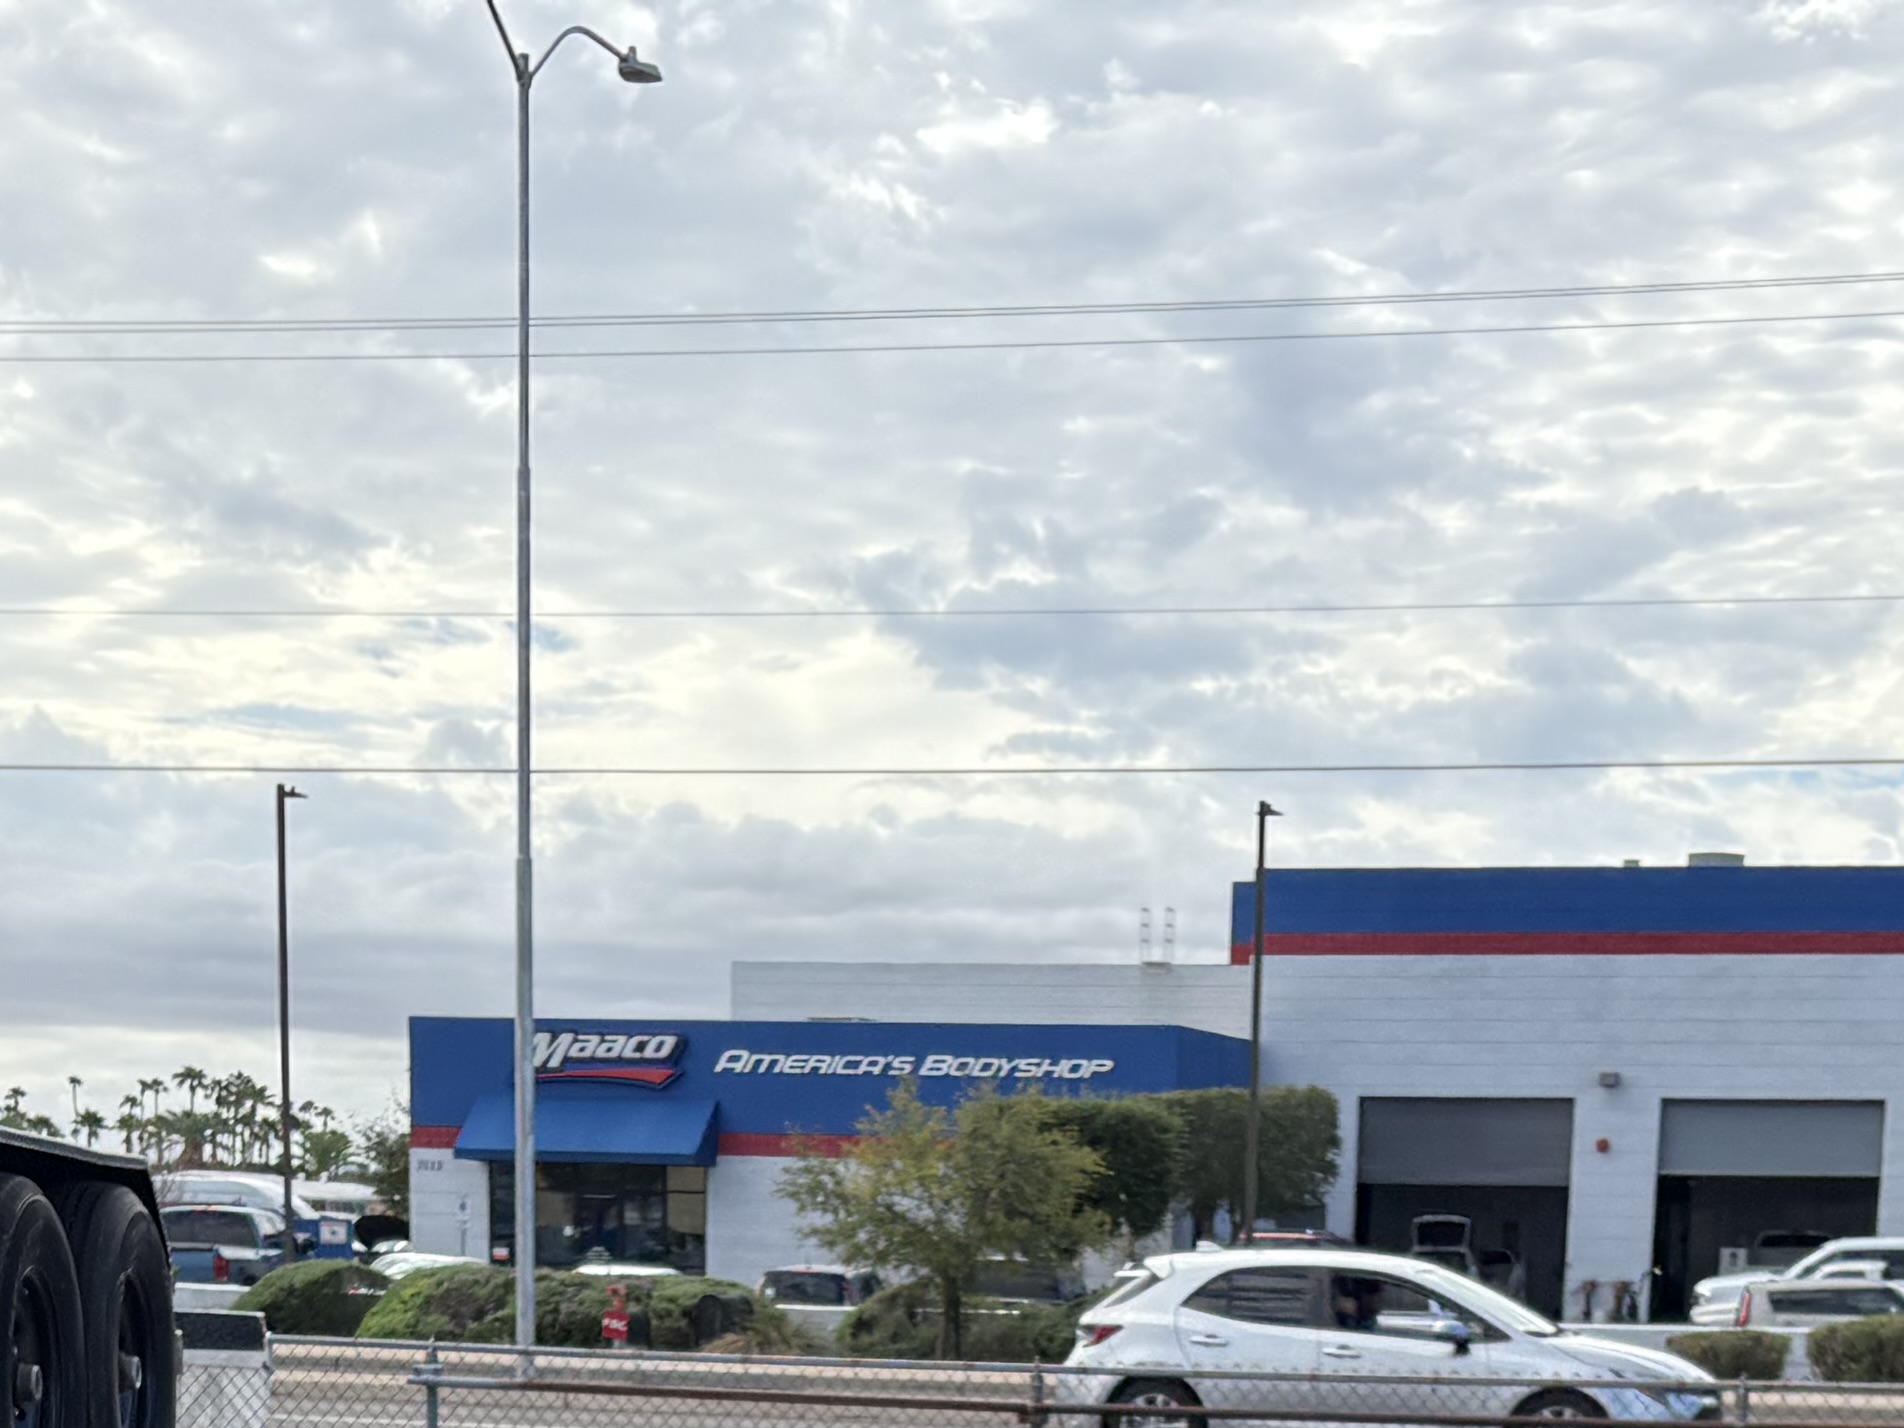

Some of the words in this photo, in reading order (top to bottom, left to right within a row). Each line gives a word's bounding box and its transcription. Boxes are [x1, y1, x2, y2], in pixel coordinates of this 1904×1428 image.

[533, 1031, 679, 1069] Maaco
[713, 1048, 915, 1076] AMERICA'S
[918, 1053, 1116, 1079] BODYSHOP
